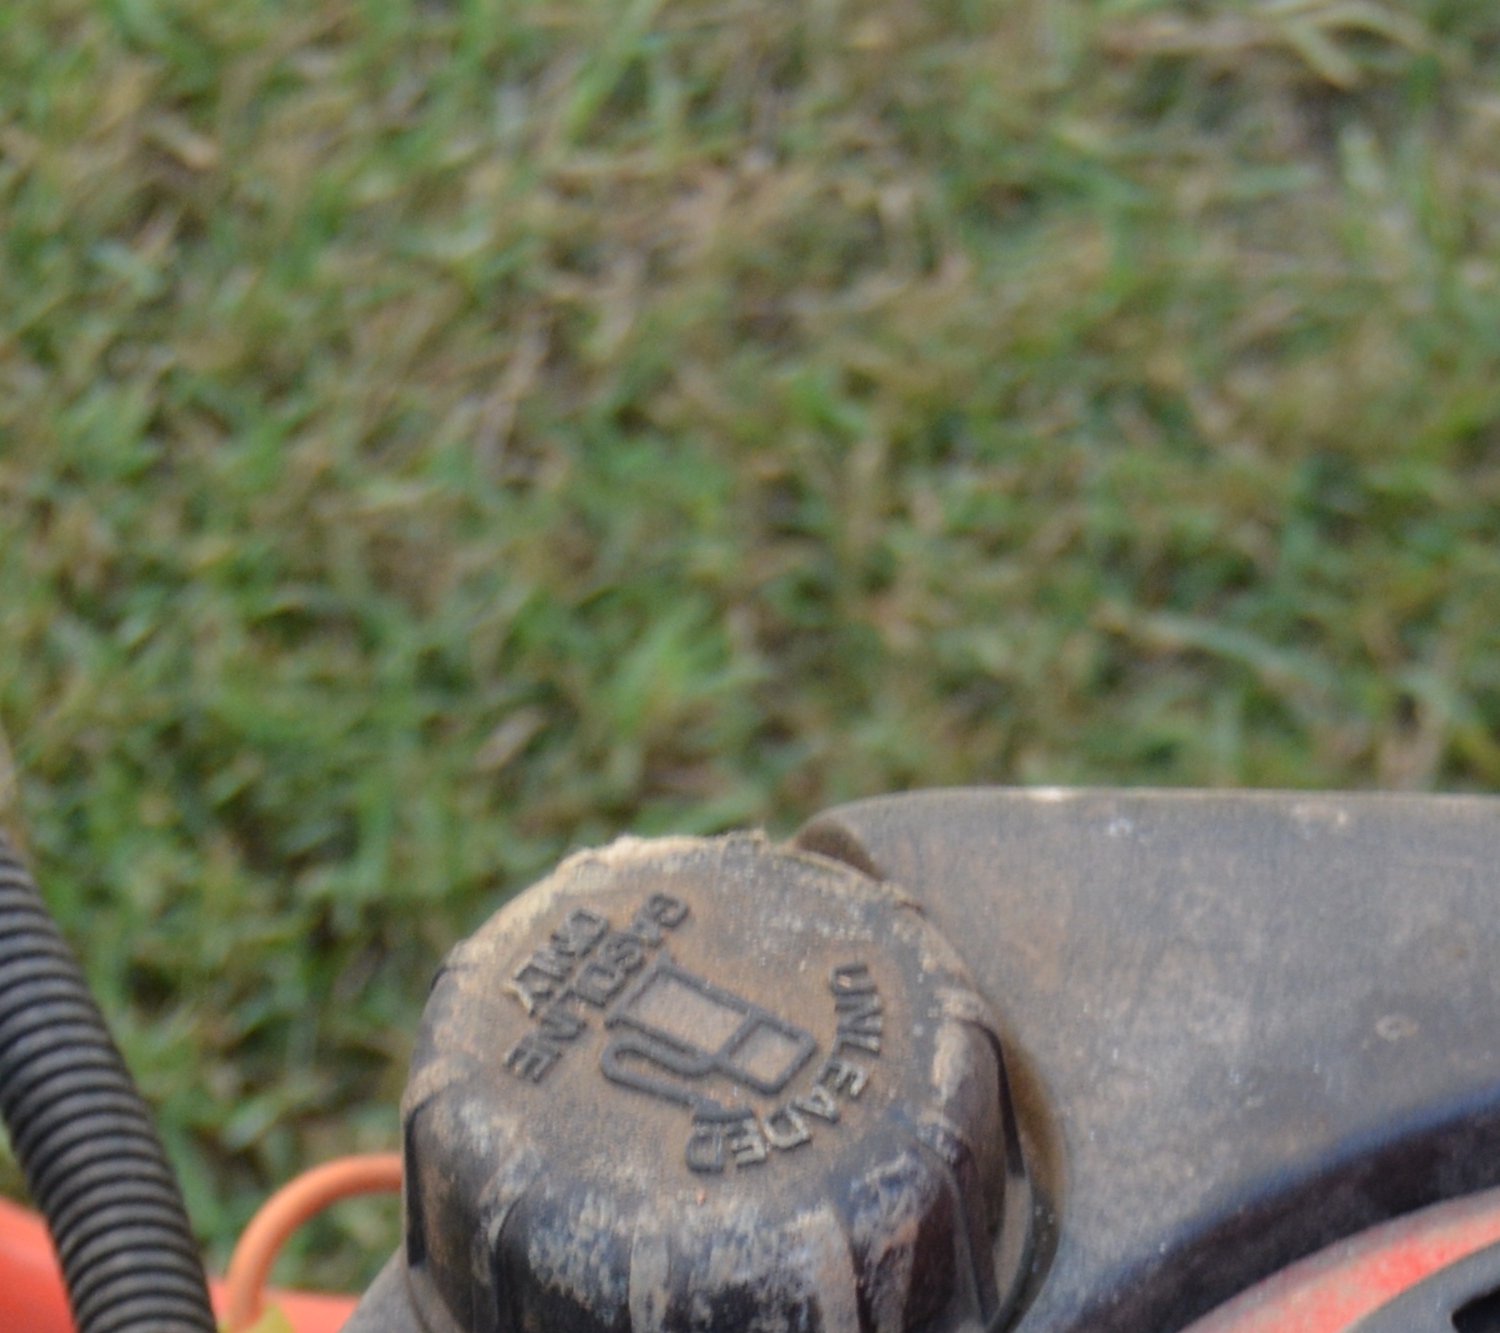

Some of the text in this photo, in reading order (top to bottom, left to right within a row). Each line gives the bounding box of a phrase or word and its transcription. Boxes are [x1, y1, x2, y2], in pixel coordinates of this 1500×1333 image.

[503, 891, 690, 1085] GASOLINE
[504, 907, 610, 1017] ONLY
[684, 962, 885, 1175] UNLEADED
